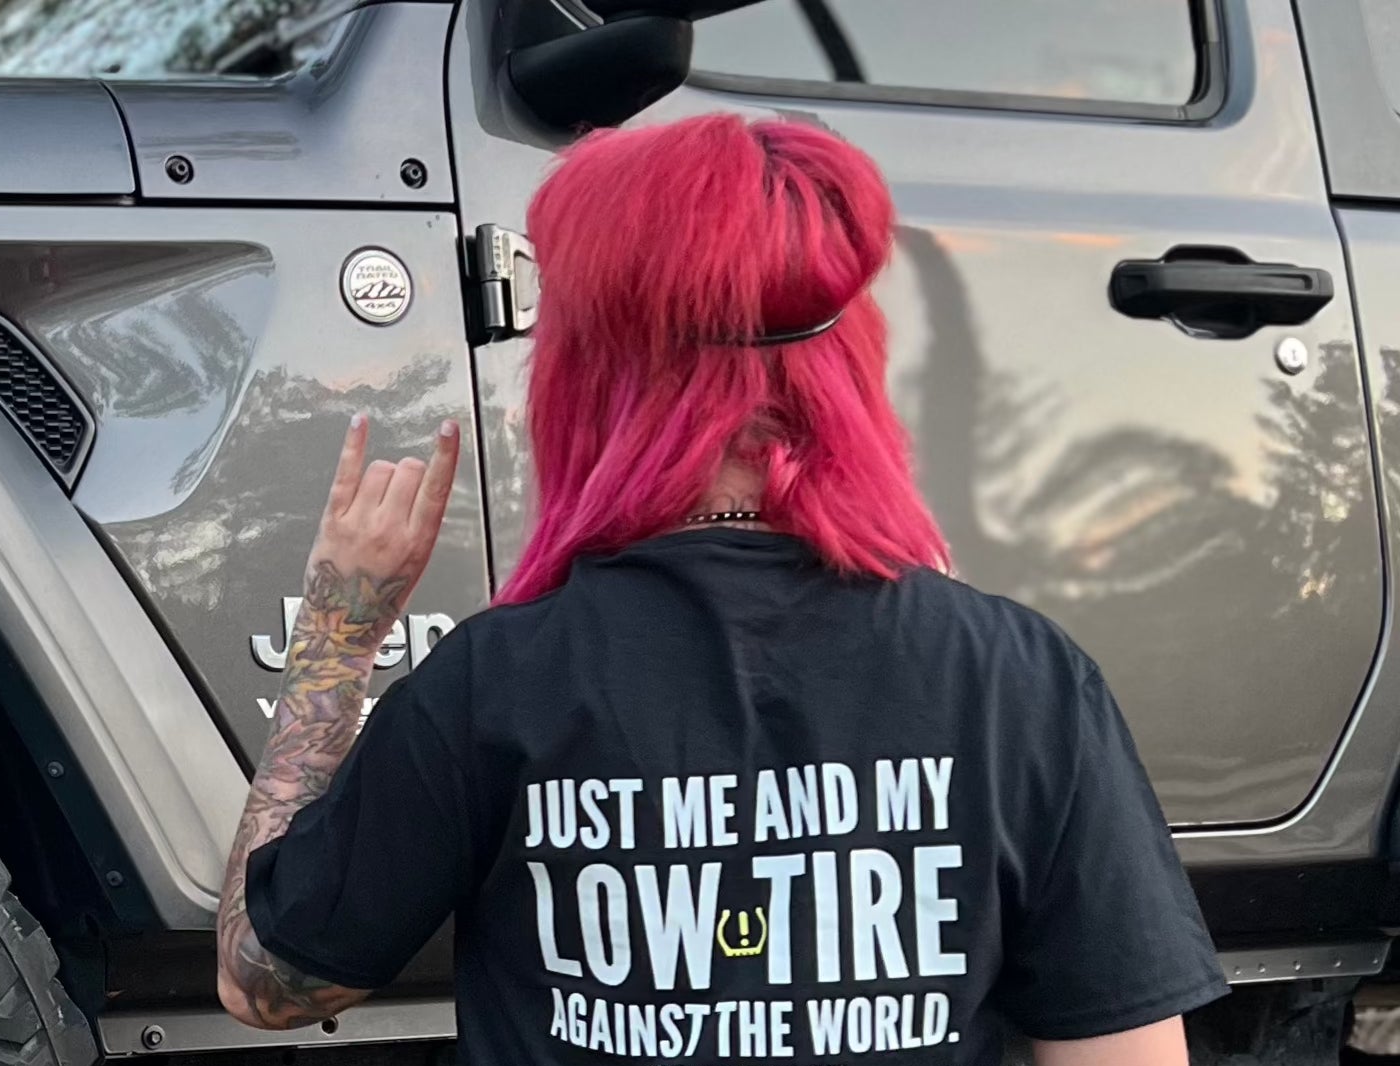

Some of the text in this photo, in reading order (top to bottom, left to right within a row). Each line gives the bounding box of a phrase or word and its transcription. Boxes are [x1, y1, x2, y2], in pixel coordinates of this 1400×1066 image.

[526, 757, 954, 849] JUST ME AND MY
[527, 845, 967, 990] LOW TIRE
[551, 988, 961, 1058] AGAINST THE WORLD.
